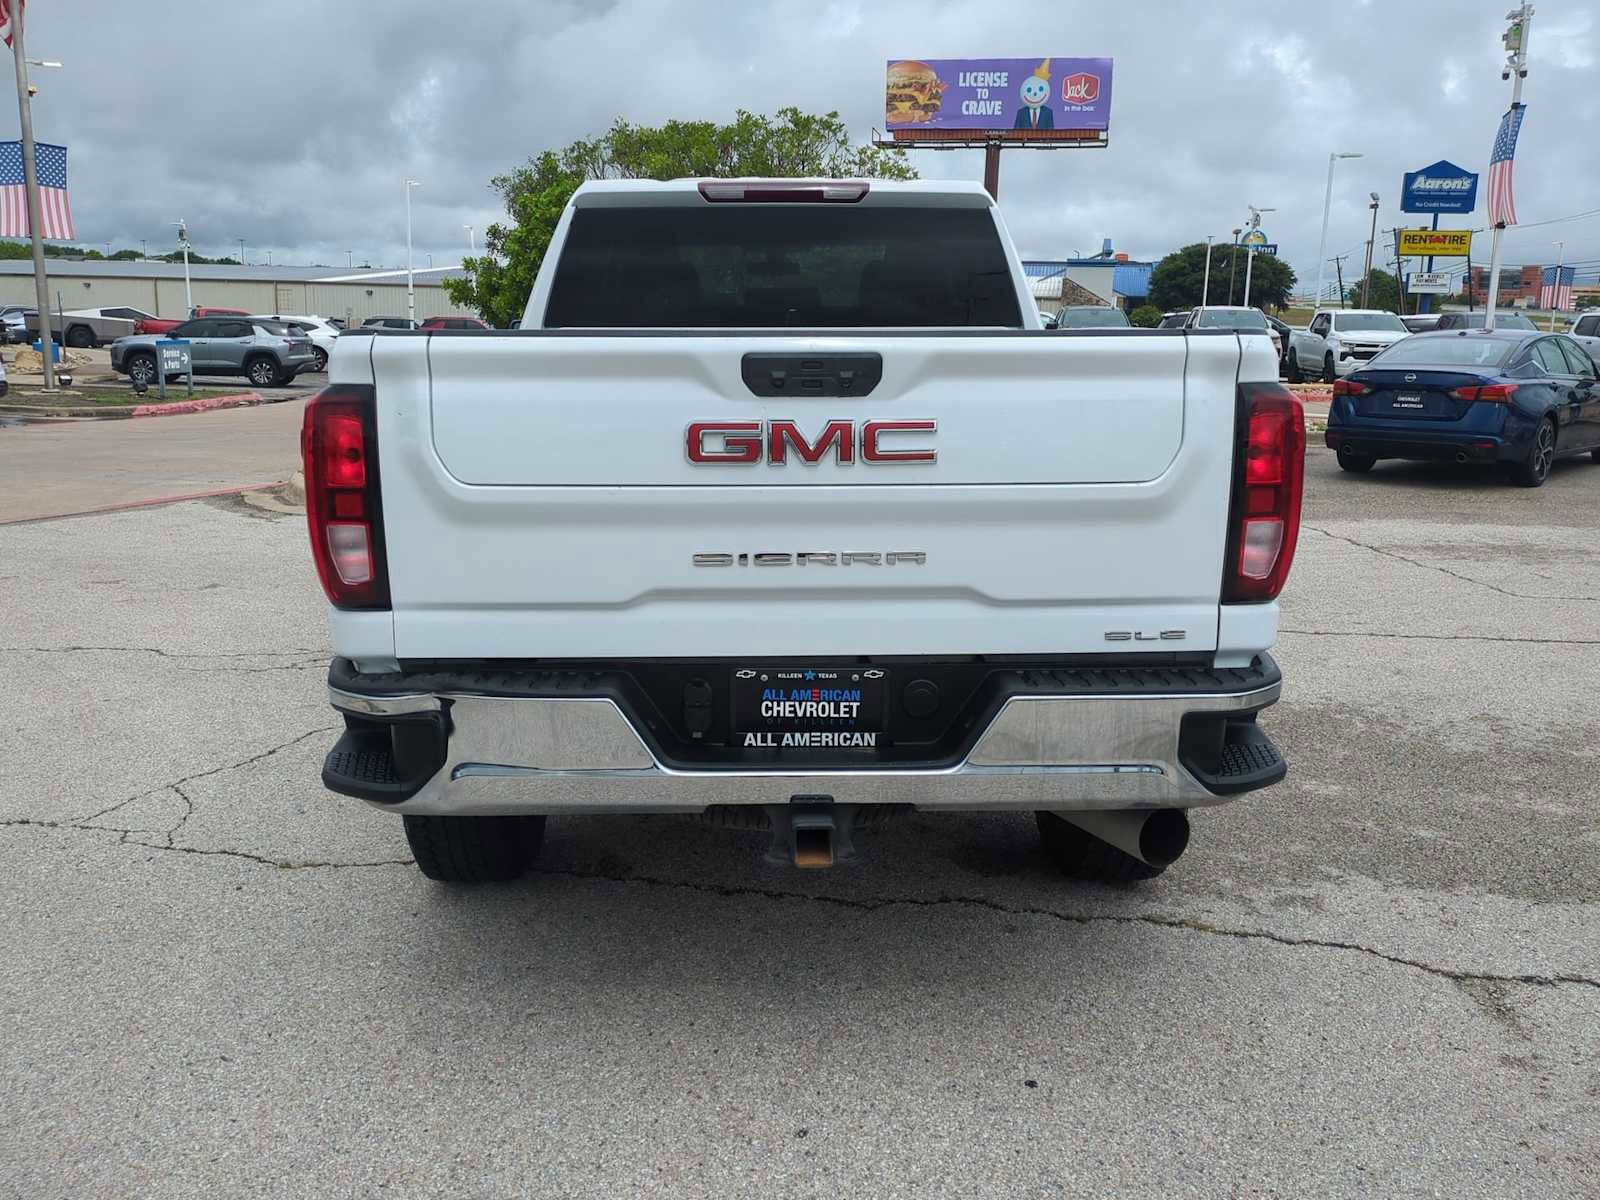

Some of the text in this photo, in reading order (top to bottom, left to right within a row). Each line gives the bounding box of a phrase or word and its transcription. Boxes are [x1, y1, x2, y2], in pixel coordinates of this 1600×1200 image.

[959, 71, 1008, 88] LICENSE
[976, 88, 989, 99] TO
[1064, 77, 1096, 99] Jack
[961, 100, 1002, 116] CRAVE
[1412, 175, 1472, 189] Aaron's
[1423, 200, 1439, 208] Credit
[684, 419, 937, 466] GMC
[692, 551, 927, 567] SIERRA
[1104, 629, 1186, 641] SLE
[762, 688, 861, 701] ALL AMERICAN
[761, 701, 860, 718] CHEVROLET
[743, 732, 876, 747] ALL AMERICAN
